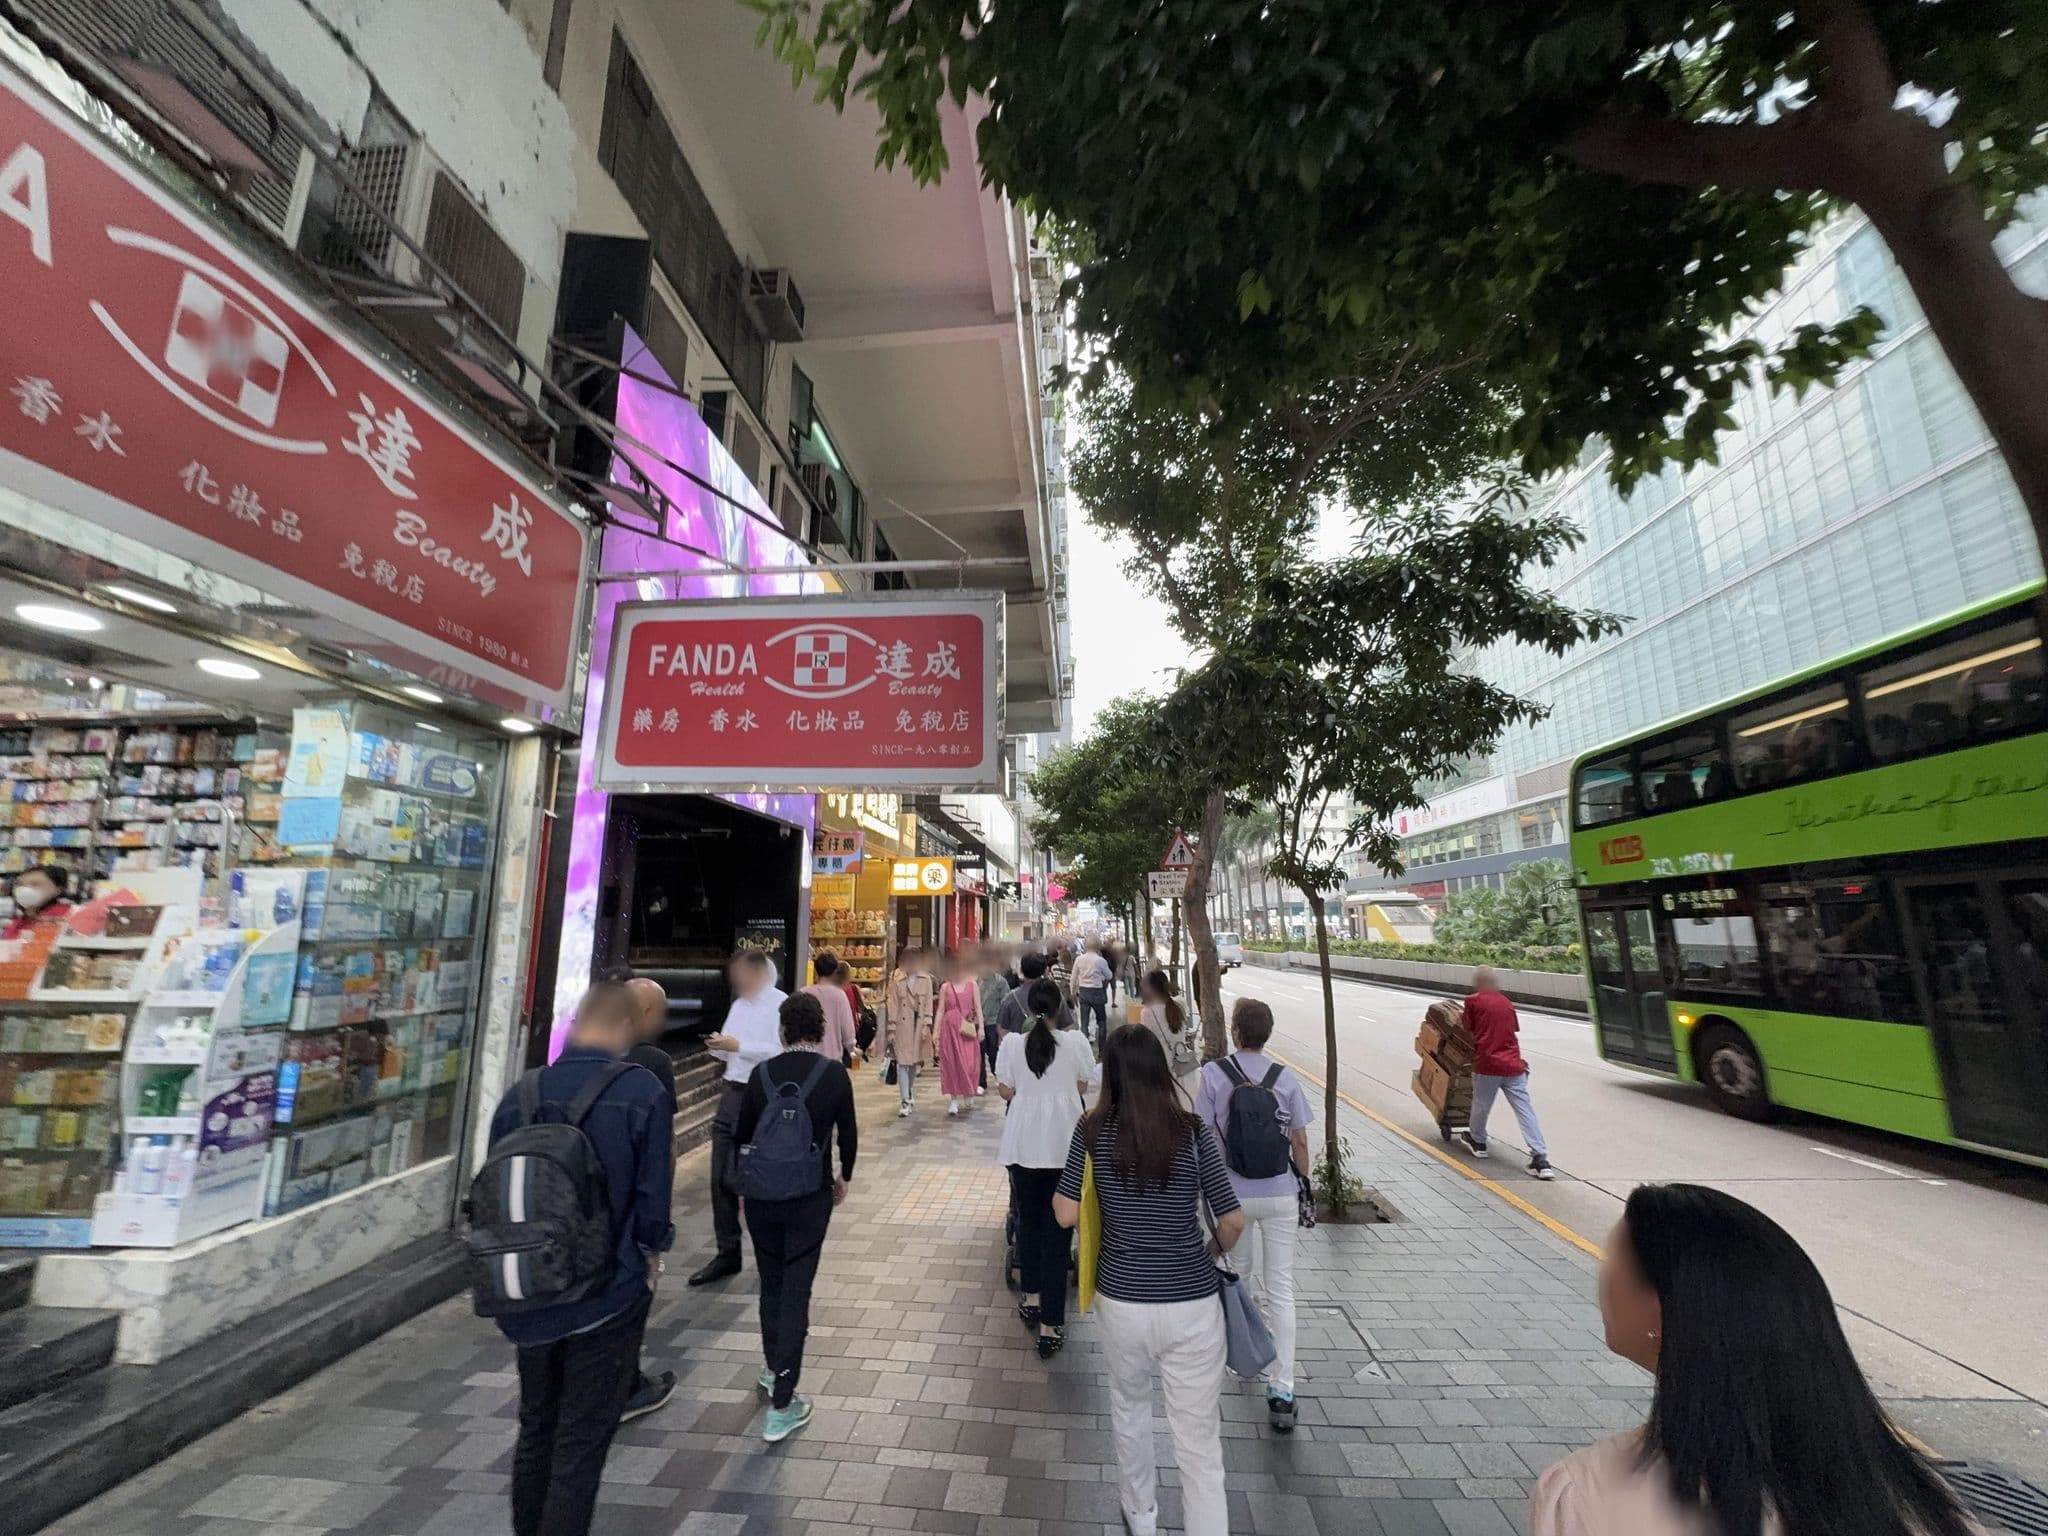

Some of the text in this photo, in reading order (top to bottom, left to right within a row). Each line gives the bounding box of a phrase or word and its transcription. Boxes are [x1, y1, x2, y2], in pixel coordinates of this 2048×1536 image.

[9, 375, 128, 458] 香水
[342, 391, 533, 577] 達成
[393, 509, 497, 598] Beauty
[438, 616, 474, 644] SINCE
[479, 635, 507, 660] 1980
[648, 643, 758, 676] FANDA
[874, 640, 961, 680] 達成
[689, 681, 746, 696] Health
[888, 681, 943, 698] Beauty
[632, 707, 680, 733] 藥房
[708, 708, 760, 732] 香水
